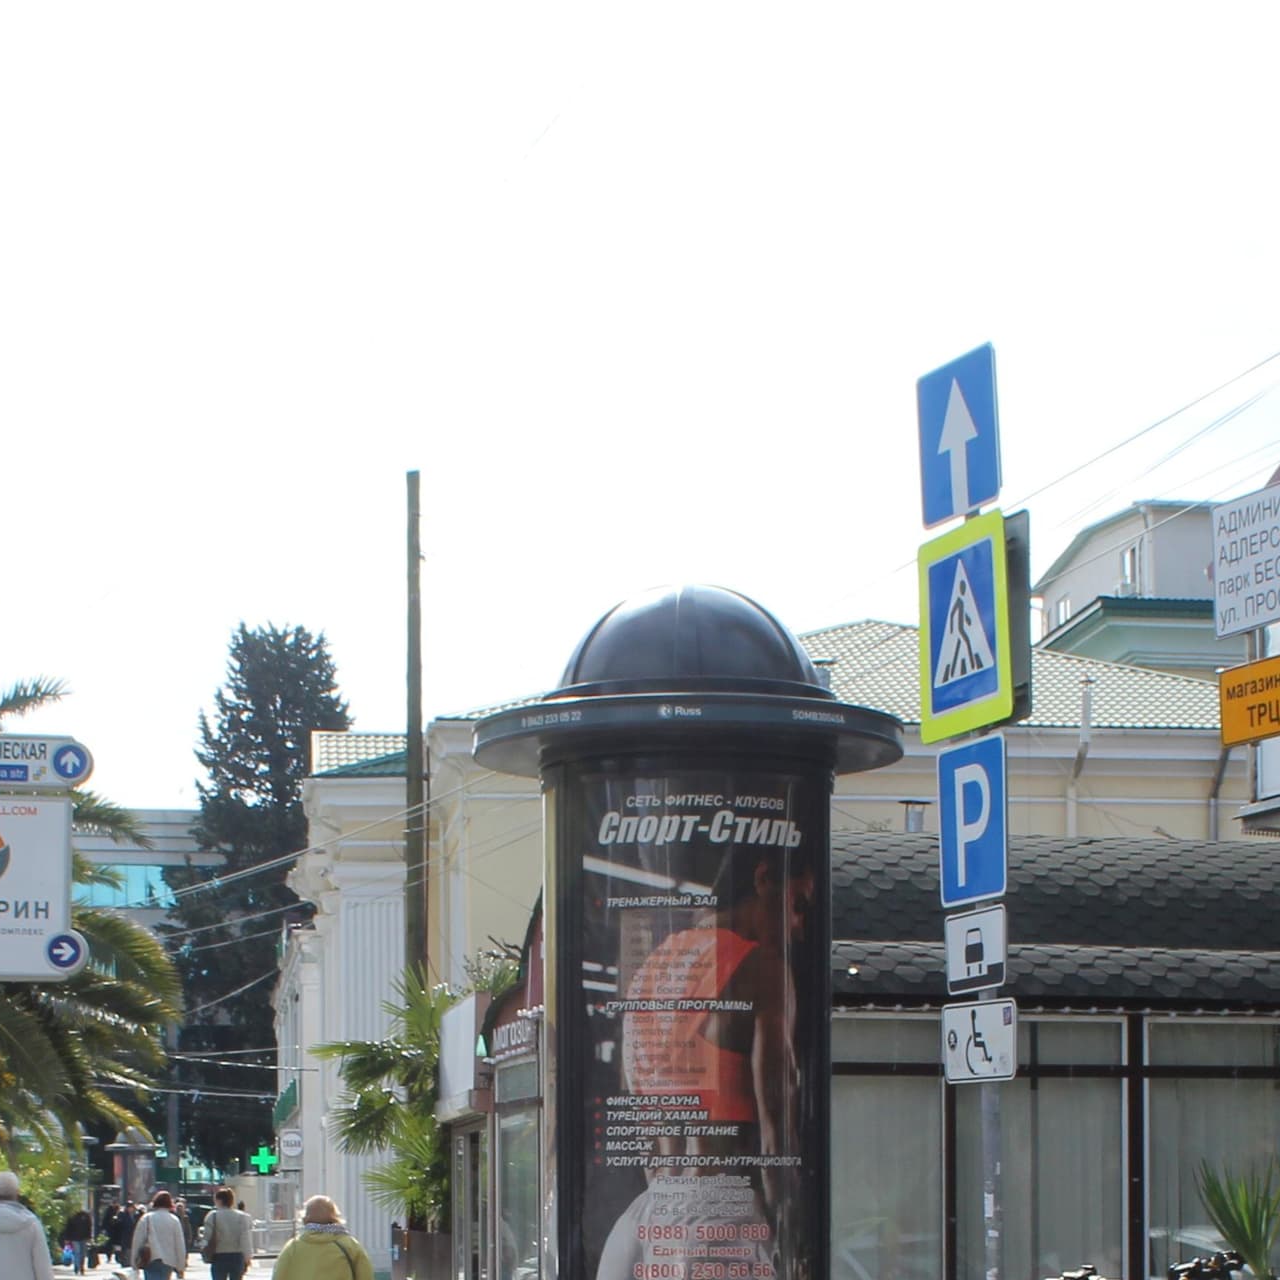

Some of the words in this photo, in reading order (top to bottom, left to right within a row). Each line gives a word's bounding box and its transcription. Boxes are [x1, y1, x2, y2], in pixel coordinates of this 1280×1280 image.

[1218, 574, 1251, 598] парк
[1219, 602, 1240, 634] ул.
[674, 706, 702, 717] Russ
[9, 769, 28, 781] str.
[626, 795, 662, 809] СЕТЬ
[664, 794, 724, 809] ФИТНЕС
[734, 795, 785, 811] КЛУБОВ
[598, 810, 802, 848] Спорт-Стиль
[606, 893, 692, 908] ТРЕНАЖЕРНЫЙ
[693, 895, 718, 907] ЗАЛ
[605, 1000, 675, 1012] ГРУППОВЫЕ
[677, 999, 753, 1012] ПРОГРАММЫ
[606, 1096, 658, 1107] ФИНСКАЯ
[660, 1096, 700, 1107] САУНА
[606, 1109, 662, 1122] ТУРЕЦКИЙ
[663, 1110, 709, 1121] ХАМАМ
[606, 1125, 681, 1137] СПОРТИВНОЕ
[683, 1126, 739, 1137] ПИТАНИЕ
[606, 1141, 654, 1152] МАССАЖ
[606, 1155, 648, 1167] УСЛУГИ
[648, 1155, 802, 1168] ДИЕТОЛОГА-НУТРИЦИОЛОГА
[656, 1175, 698, 1185] Режим
[638, 1224, 689, 1241] 8(988)
[696, 1225, 736, 1240] 5000
[741, 1224, 770, 1240] 880
[652, 1245, 709, 1257] Единый
[710, 1246, 753, 1258] номер
[634, 1263, 687, 1280] 8(800)
[691, 1264, 726, 1280] 250
[728, 1264, 749, 1279] 56
[752, 1264, 772, 1278] 56
